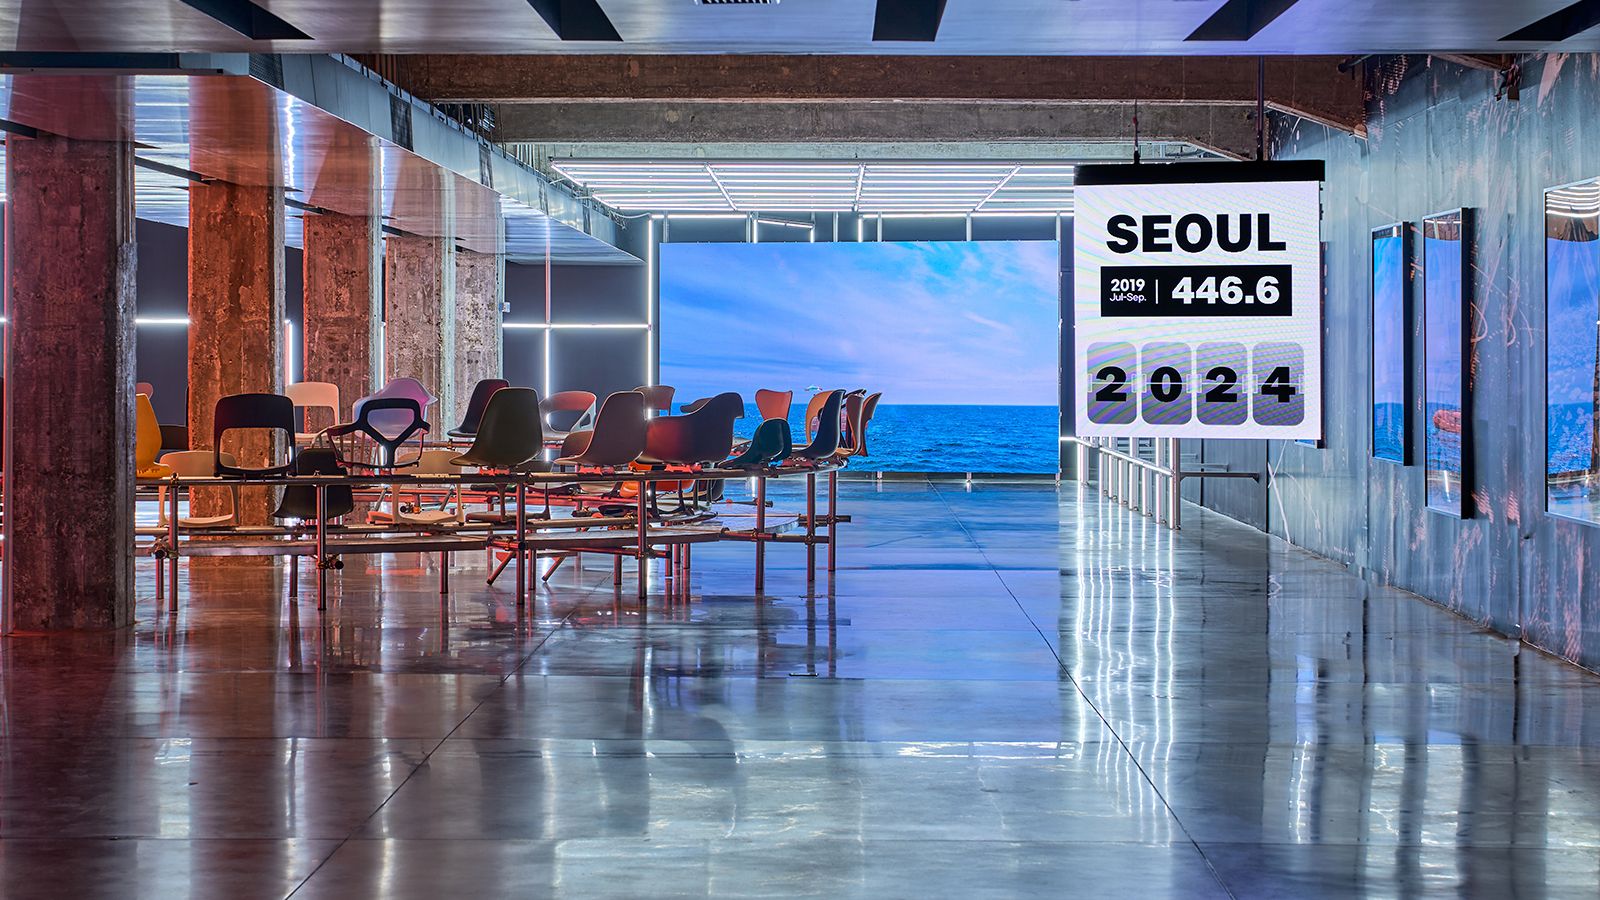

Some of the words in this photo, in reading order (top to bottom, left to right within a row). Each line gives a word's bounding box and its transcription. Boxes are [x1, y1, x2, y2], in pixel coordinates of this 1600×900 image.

[1106, 213, 1287, 254] SEOUL
[1110, 278, 1146, 292] 2019
[1171, 275, 1280, 305] 446.6
[1109, 292, 1147, 304] Jul-Sep.
